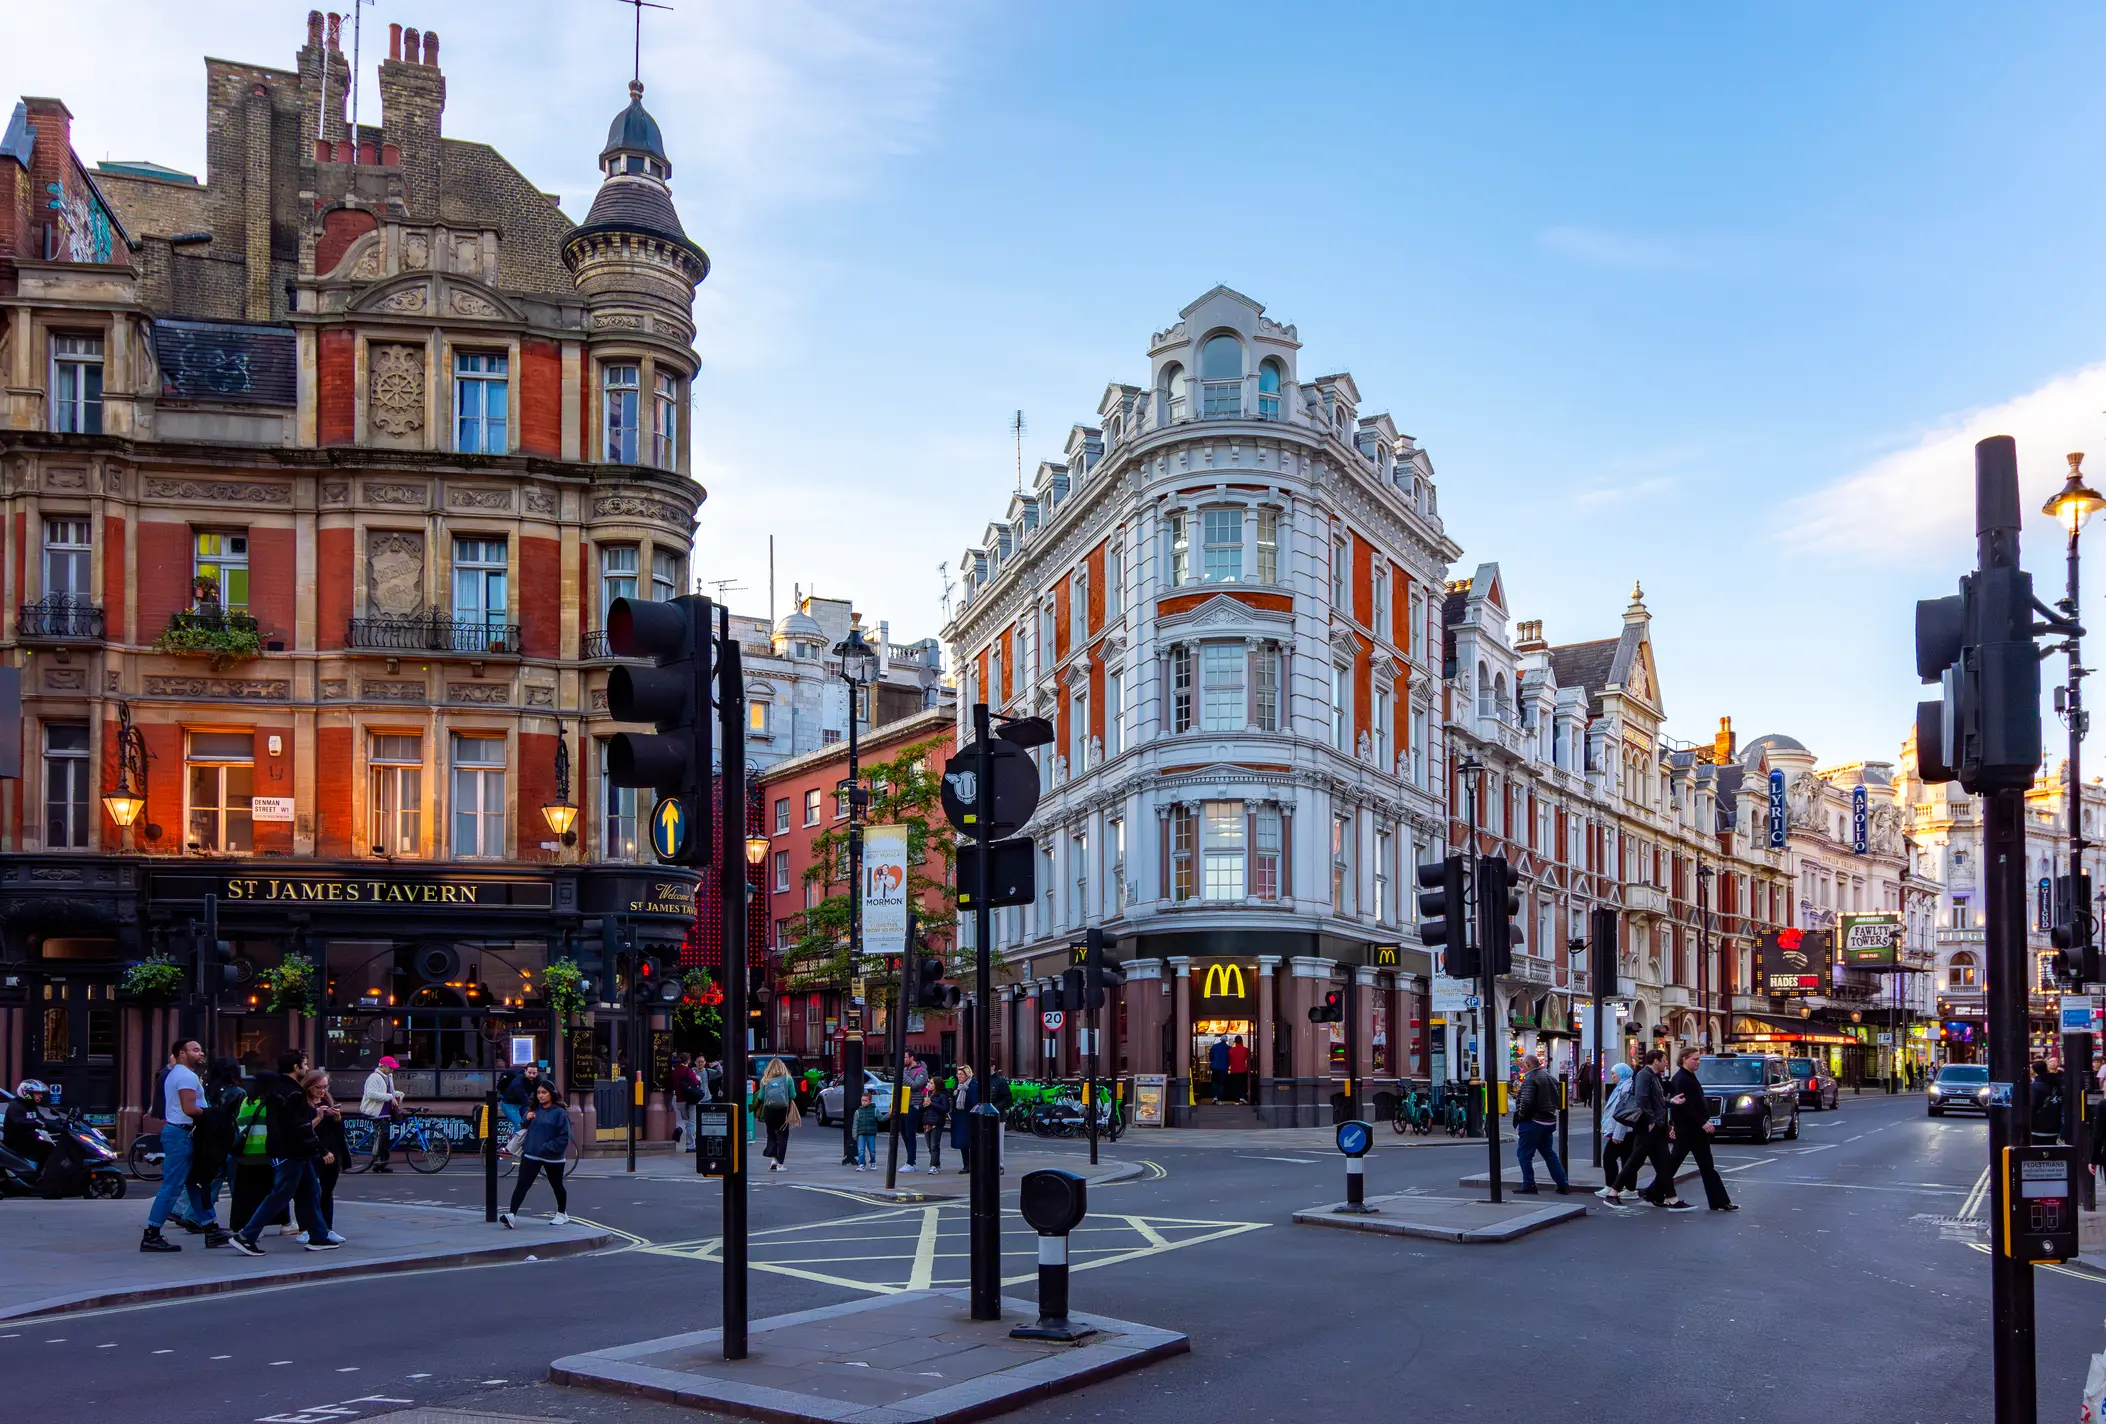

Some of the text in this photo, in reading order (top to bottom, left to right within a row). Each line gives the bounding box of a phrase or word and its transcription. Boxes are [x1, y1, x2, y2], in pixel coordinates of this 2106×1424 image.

[1771, 783, 1783, 842] LYRIC
[1855, 795, 1865, 851] APOLLO
[266, 880, 360, 901] JAMES
[367, 882, 478, 903] TAVERN
[655, 883, 690, 900] Welcome
[646, 902, 680, 913] JAMES
[866, 898, 903, 906] MORMON
[2041, 887, 2050, 928] GIELGUD
[1855, 926, 1889, 937] FAWLTY
[1850, 936, 1889, 947] TOWERS
[809, 959, 820, 971] SEE
[1045, 1013, 1062, 1024] 20
[343, 1119, 374, 1129] OCKTAILS
